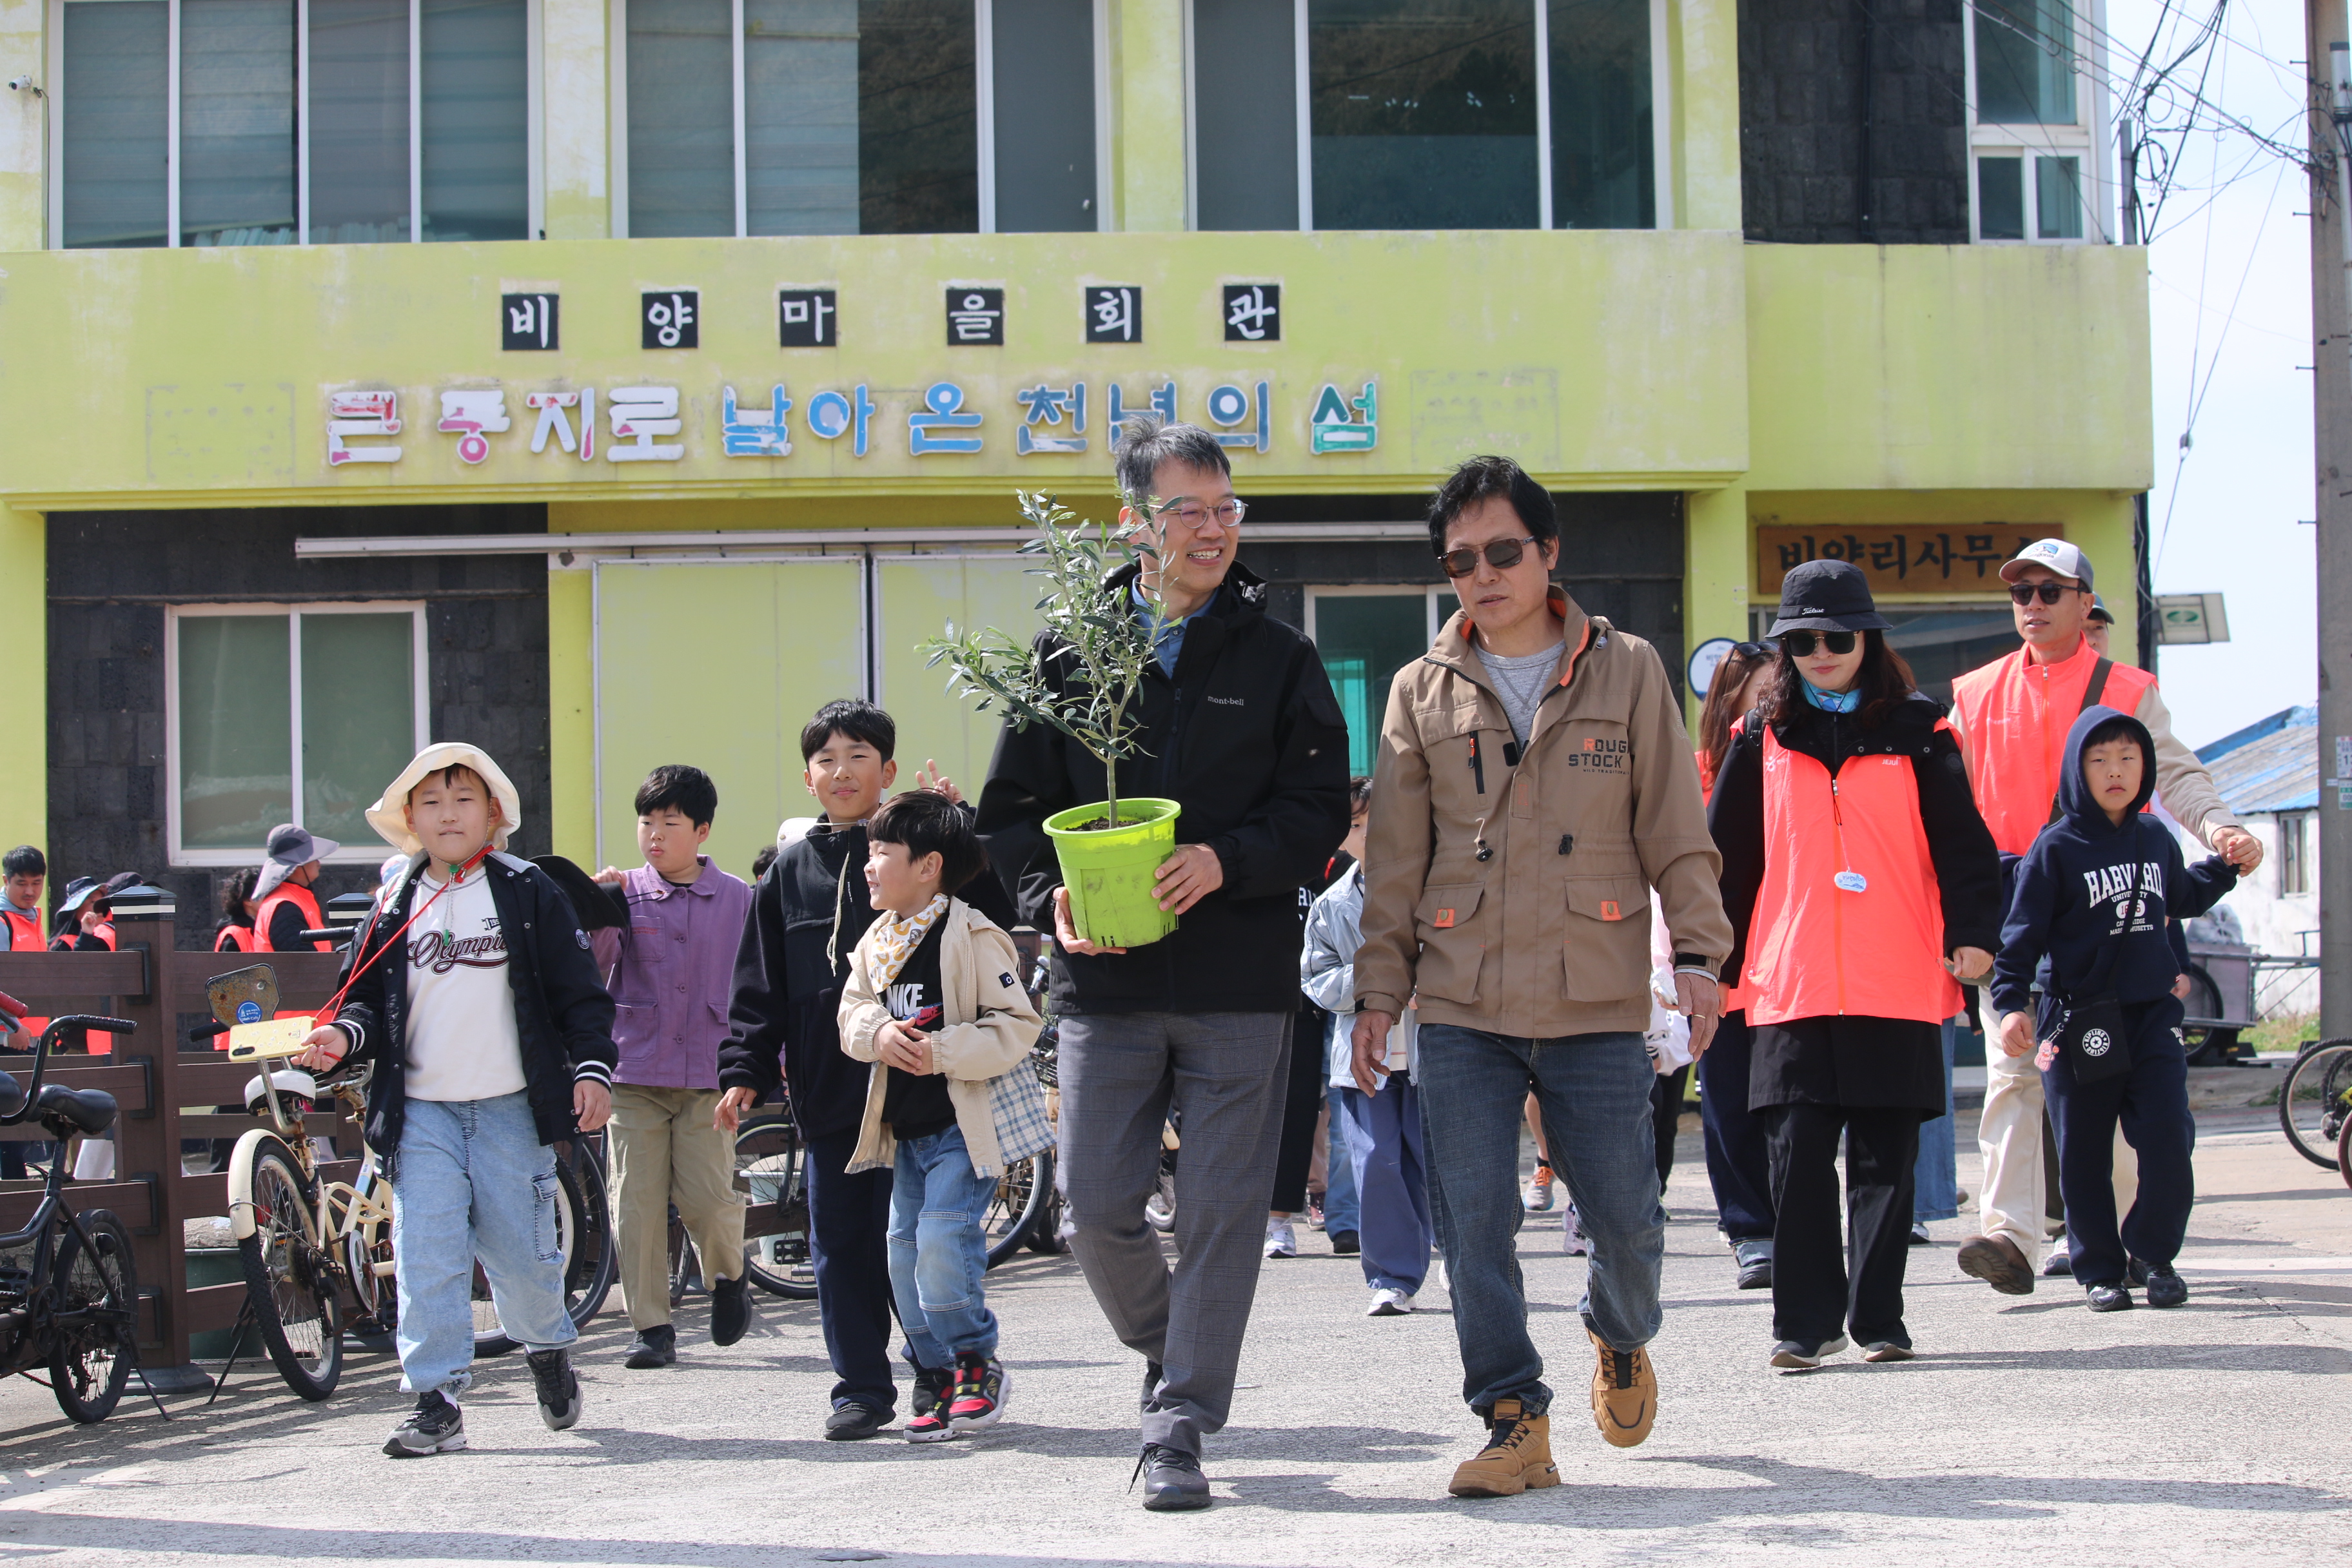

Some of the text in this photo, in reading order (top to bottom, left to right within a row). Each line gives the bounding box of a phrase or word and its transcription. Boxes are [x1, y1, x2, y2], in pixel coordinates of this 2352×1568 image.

[723, 381, 984, 458] 날아온
[1017, 380, 1270, 456] 천년의
[1310, 380, 1378, 455] 섬
[1569, 753, 1623, 769] STOCK
[2083, 862, 2163, 908] HARVRD
[886, 983, 924, 1017] NIKE
[2084, 1030, 2105, 1043] KIPLING
